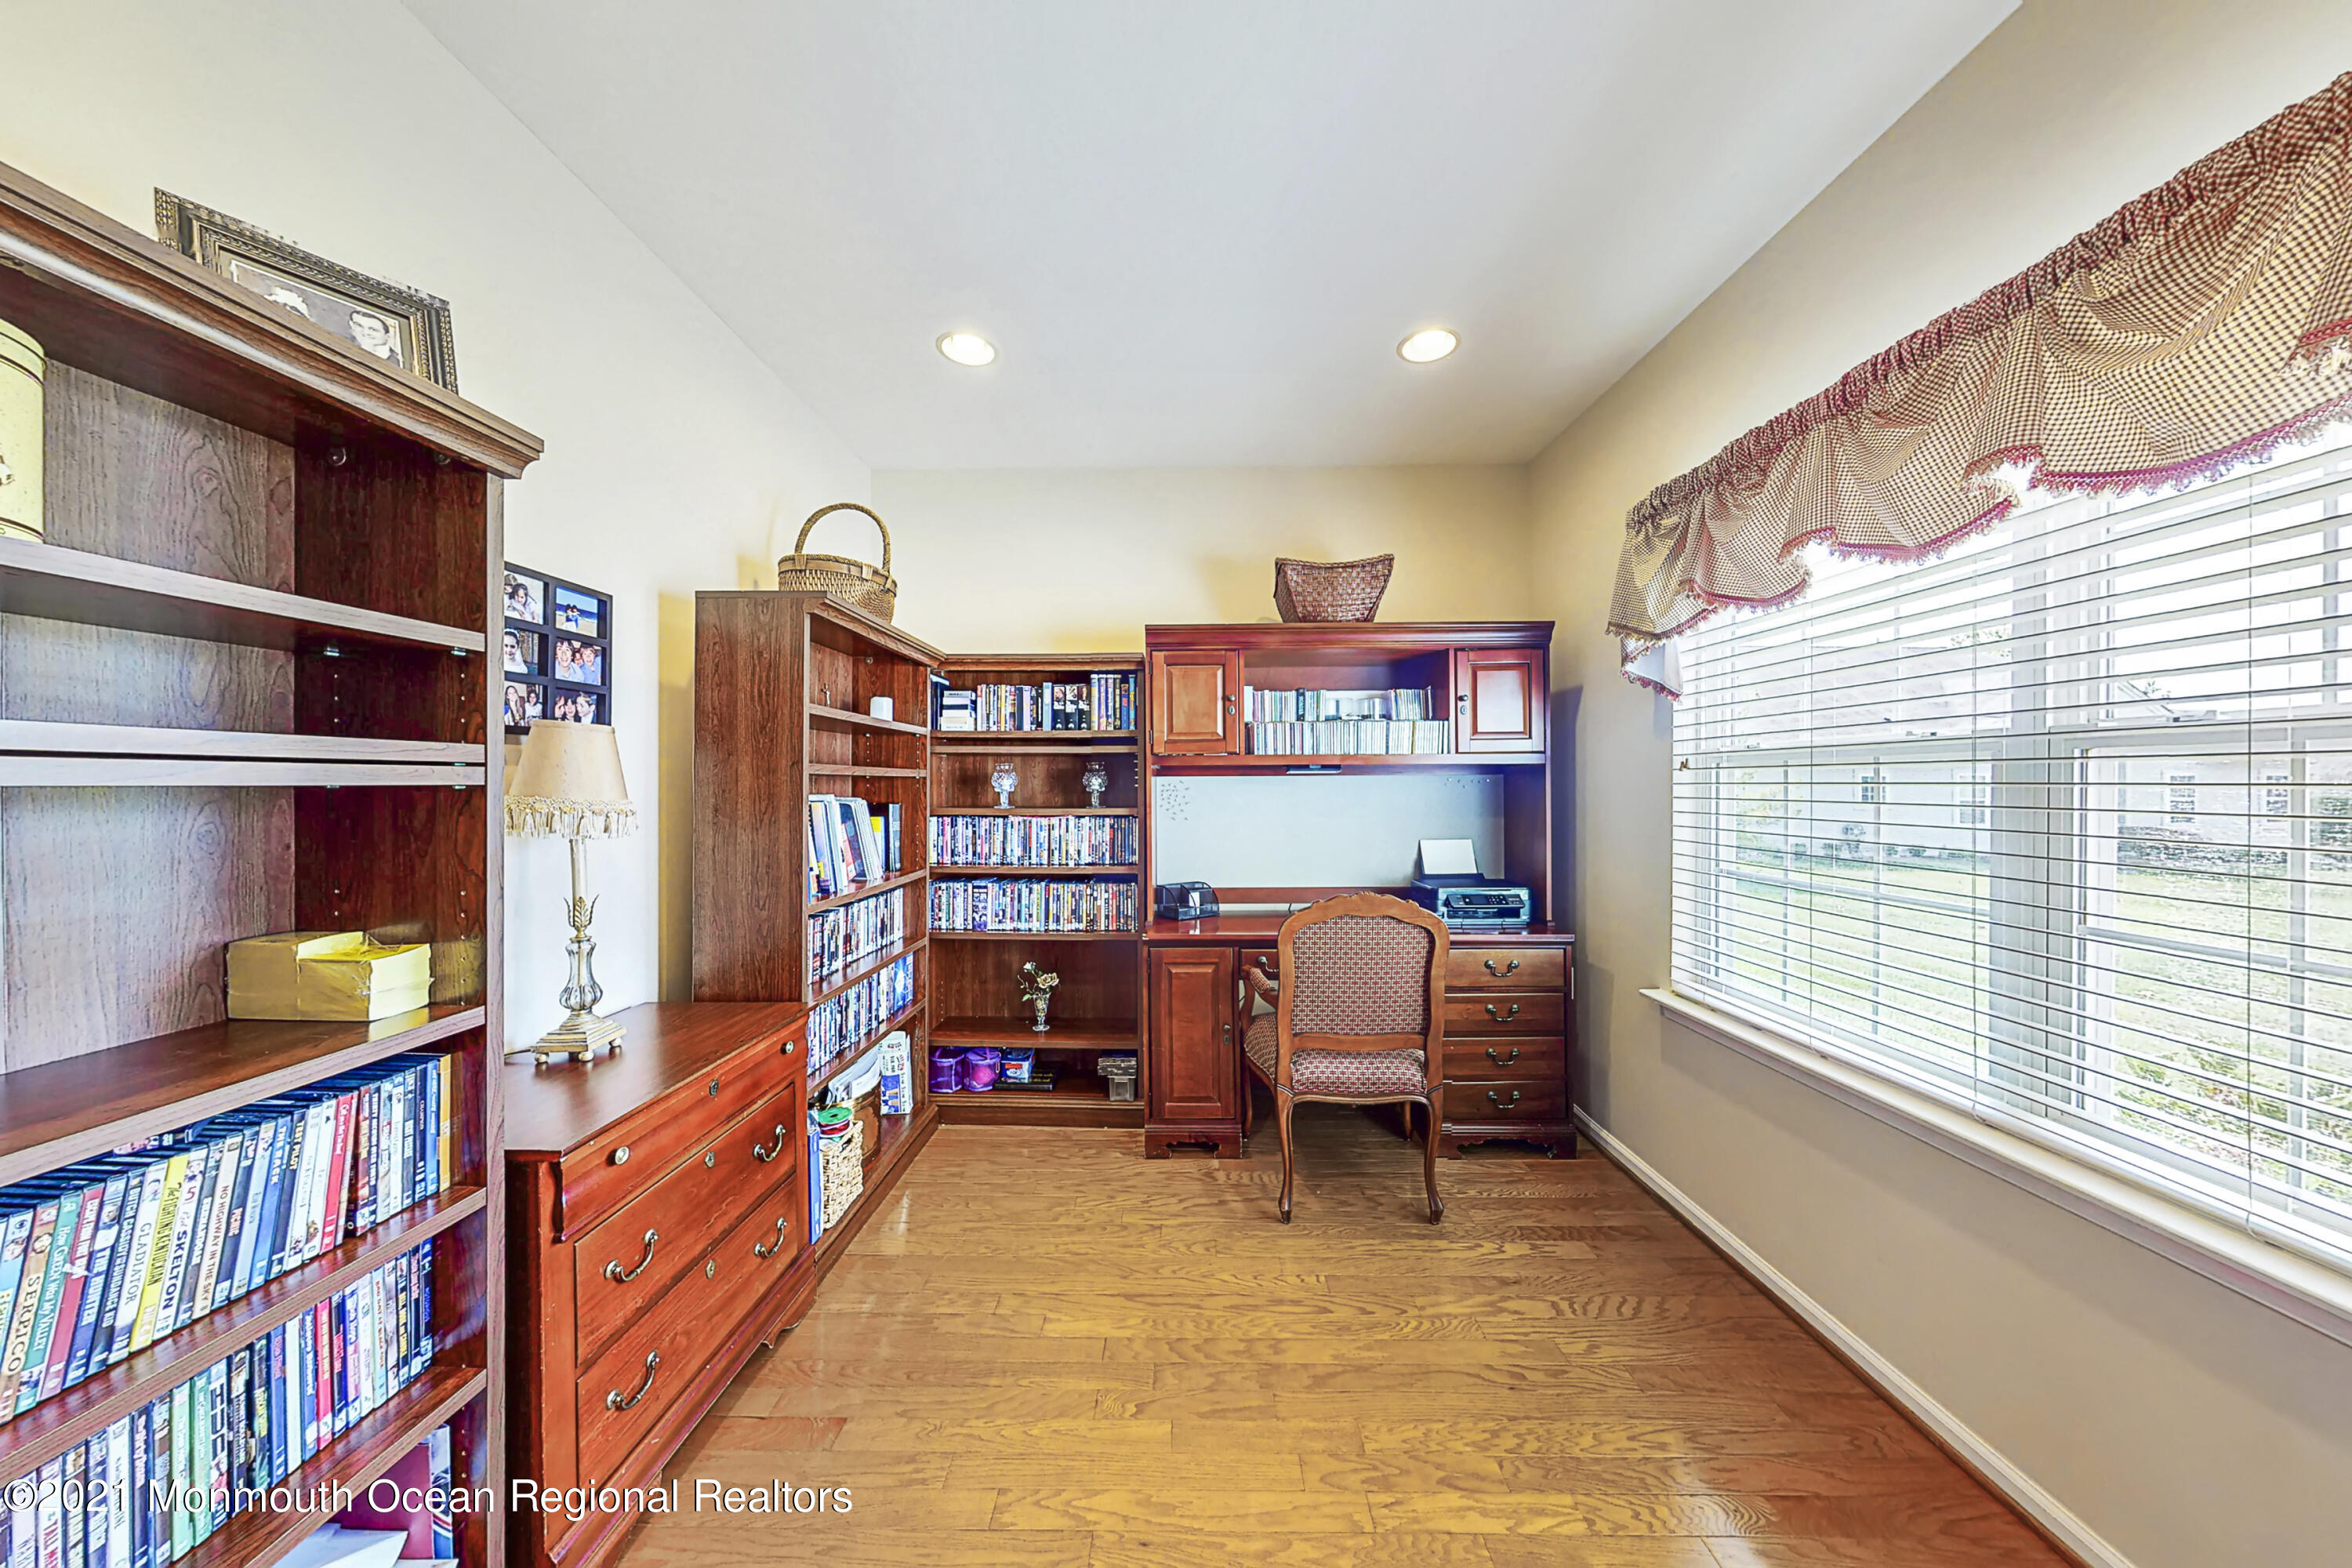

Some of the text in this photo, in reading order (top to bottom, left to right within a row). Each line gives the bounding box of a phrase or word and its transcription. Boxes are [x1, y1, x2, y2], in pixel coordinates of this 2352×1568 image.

[270, 1125, 288, 1185] THE RACK
[289, 1120, 304, 1171] TEST PILOT
[125, 1186, 140, 1217] BUTCH
[147, 1181, 183, 1286] The FIGHTING KENTUCKIAN
[227, 1206, 243, 1237] PICNIC
[118, 1216, 135, 1257] CASSIDY
[125, 1221, 152, 1304] GLADIATOR
[162, 1229, 188, 1310] SKELTON
[199, 1185, 230, 1302] NO HIGHWAY IN THE SKY
[31, 1224, 71, 1352] How GREEN Was My VALLEY
[81, 1247, 110, 1326] THE HUNTER
[107, 1261, 125, 1309] SUNDANCE
[7, 1275, 41, 1373] SERPICO
[102, 1309, 116, 1328] KID
[210, 1383, 227, 1456] HUD
[44, 1519, 58, 1550] TALL
